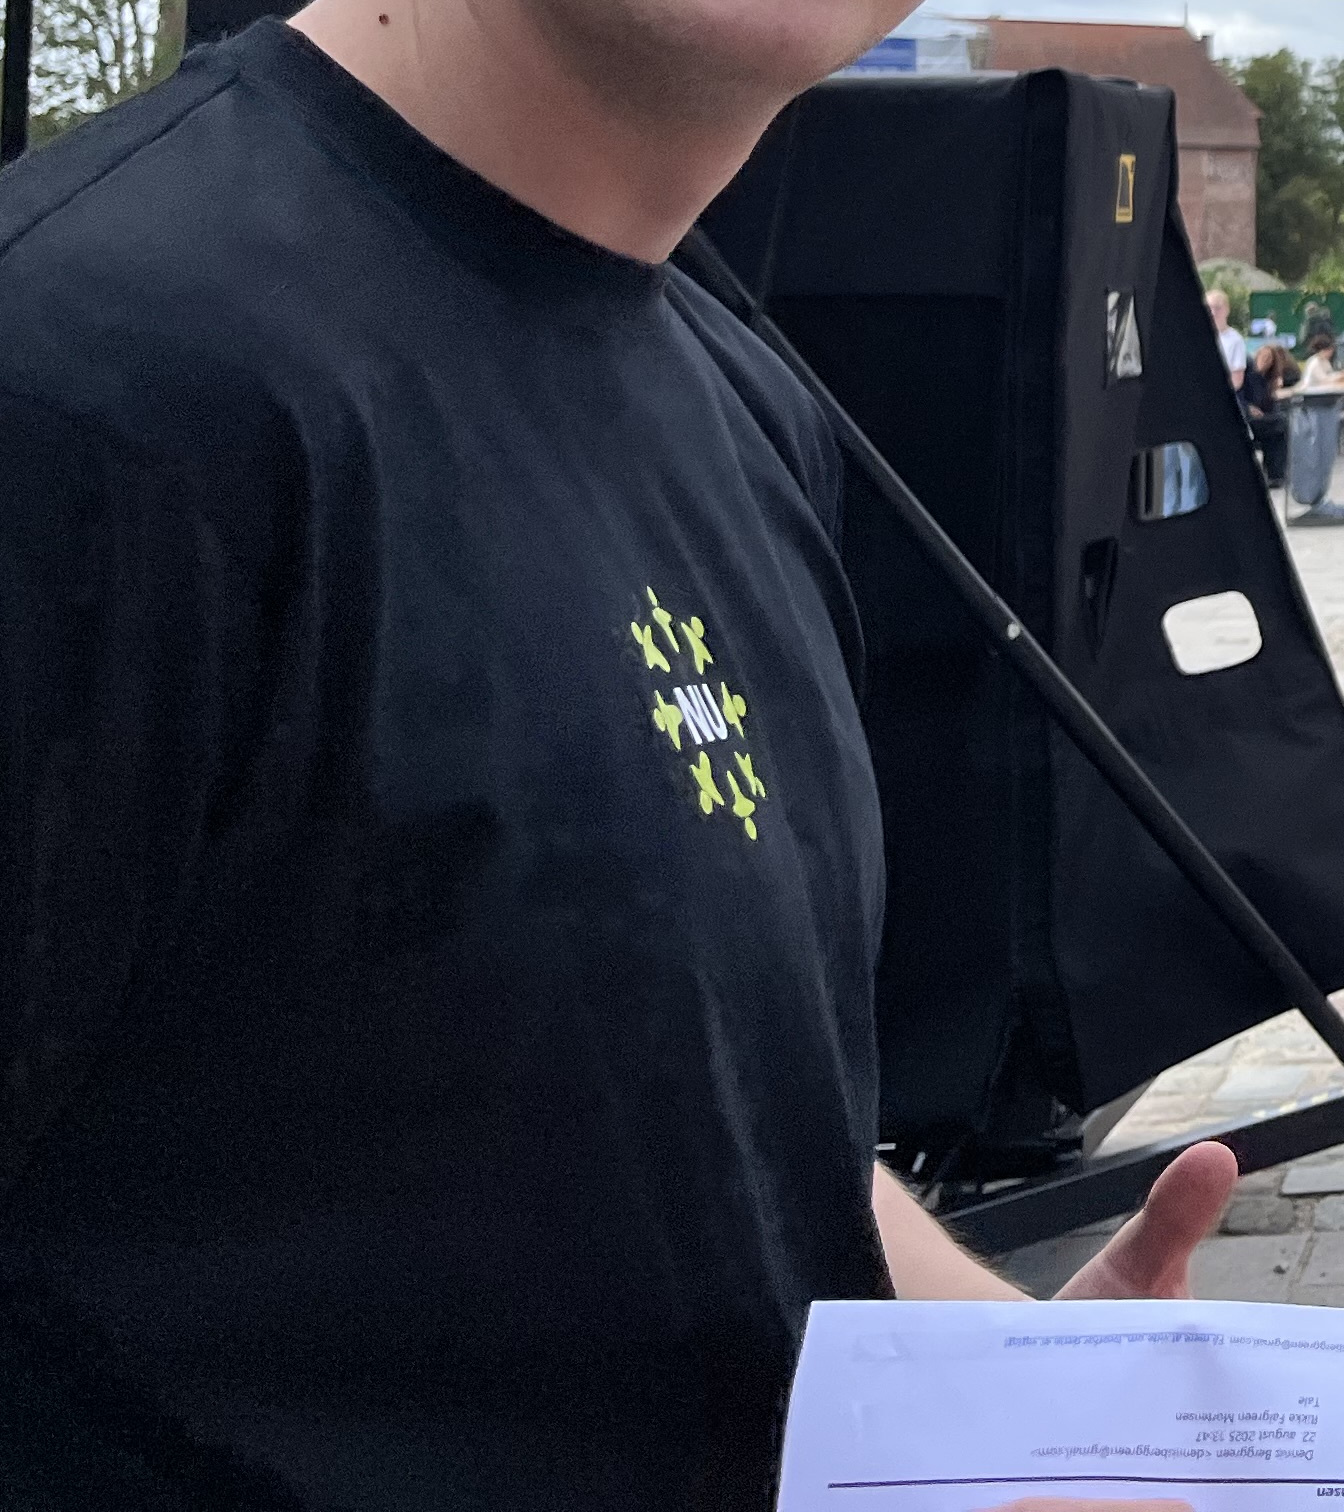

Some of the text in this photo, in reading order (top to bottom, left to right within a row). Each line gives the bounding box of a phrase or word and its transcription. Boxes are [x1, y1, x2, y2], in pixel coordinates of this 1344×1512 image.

[673, 683, 728, 745] NU
[1298, 1397, 1320, 1407] Tale
[1176, 1410, 1318, 1424] Rikke Falgreen Mortensen
[1230, 1430, 1256, 1442] 2025
[1259, 1428, 1296, 1441] august
[1216, 1446, 1272, 1460] Berggreen
[1276, 1449, 1314, 1460] Dennis
